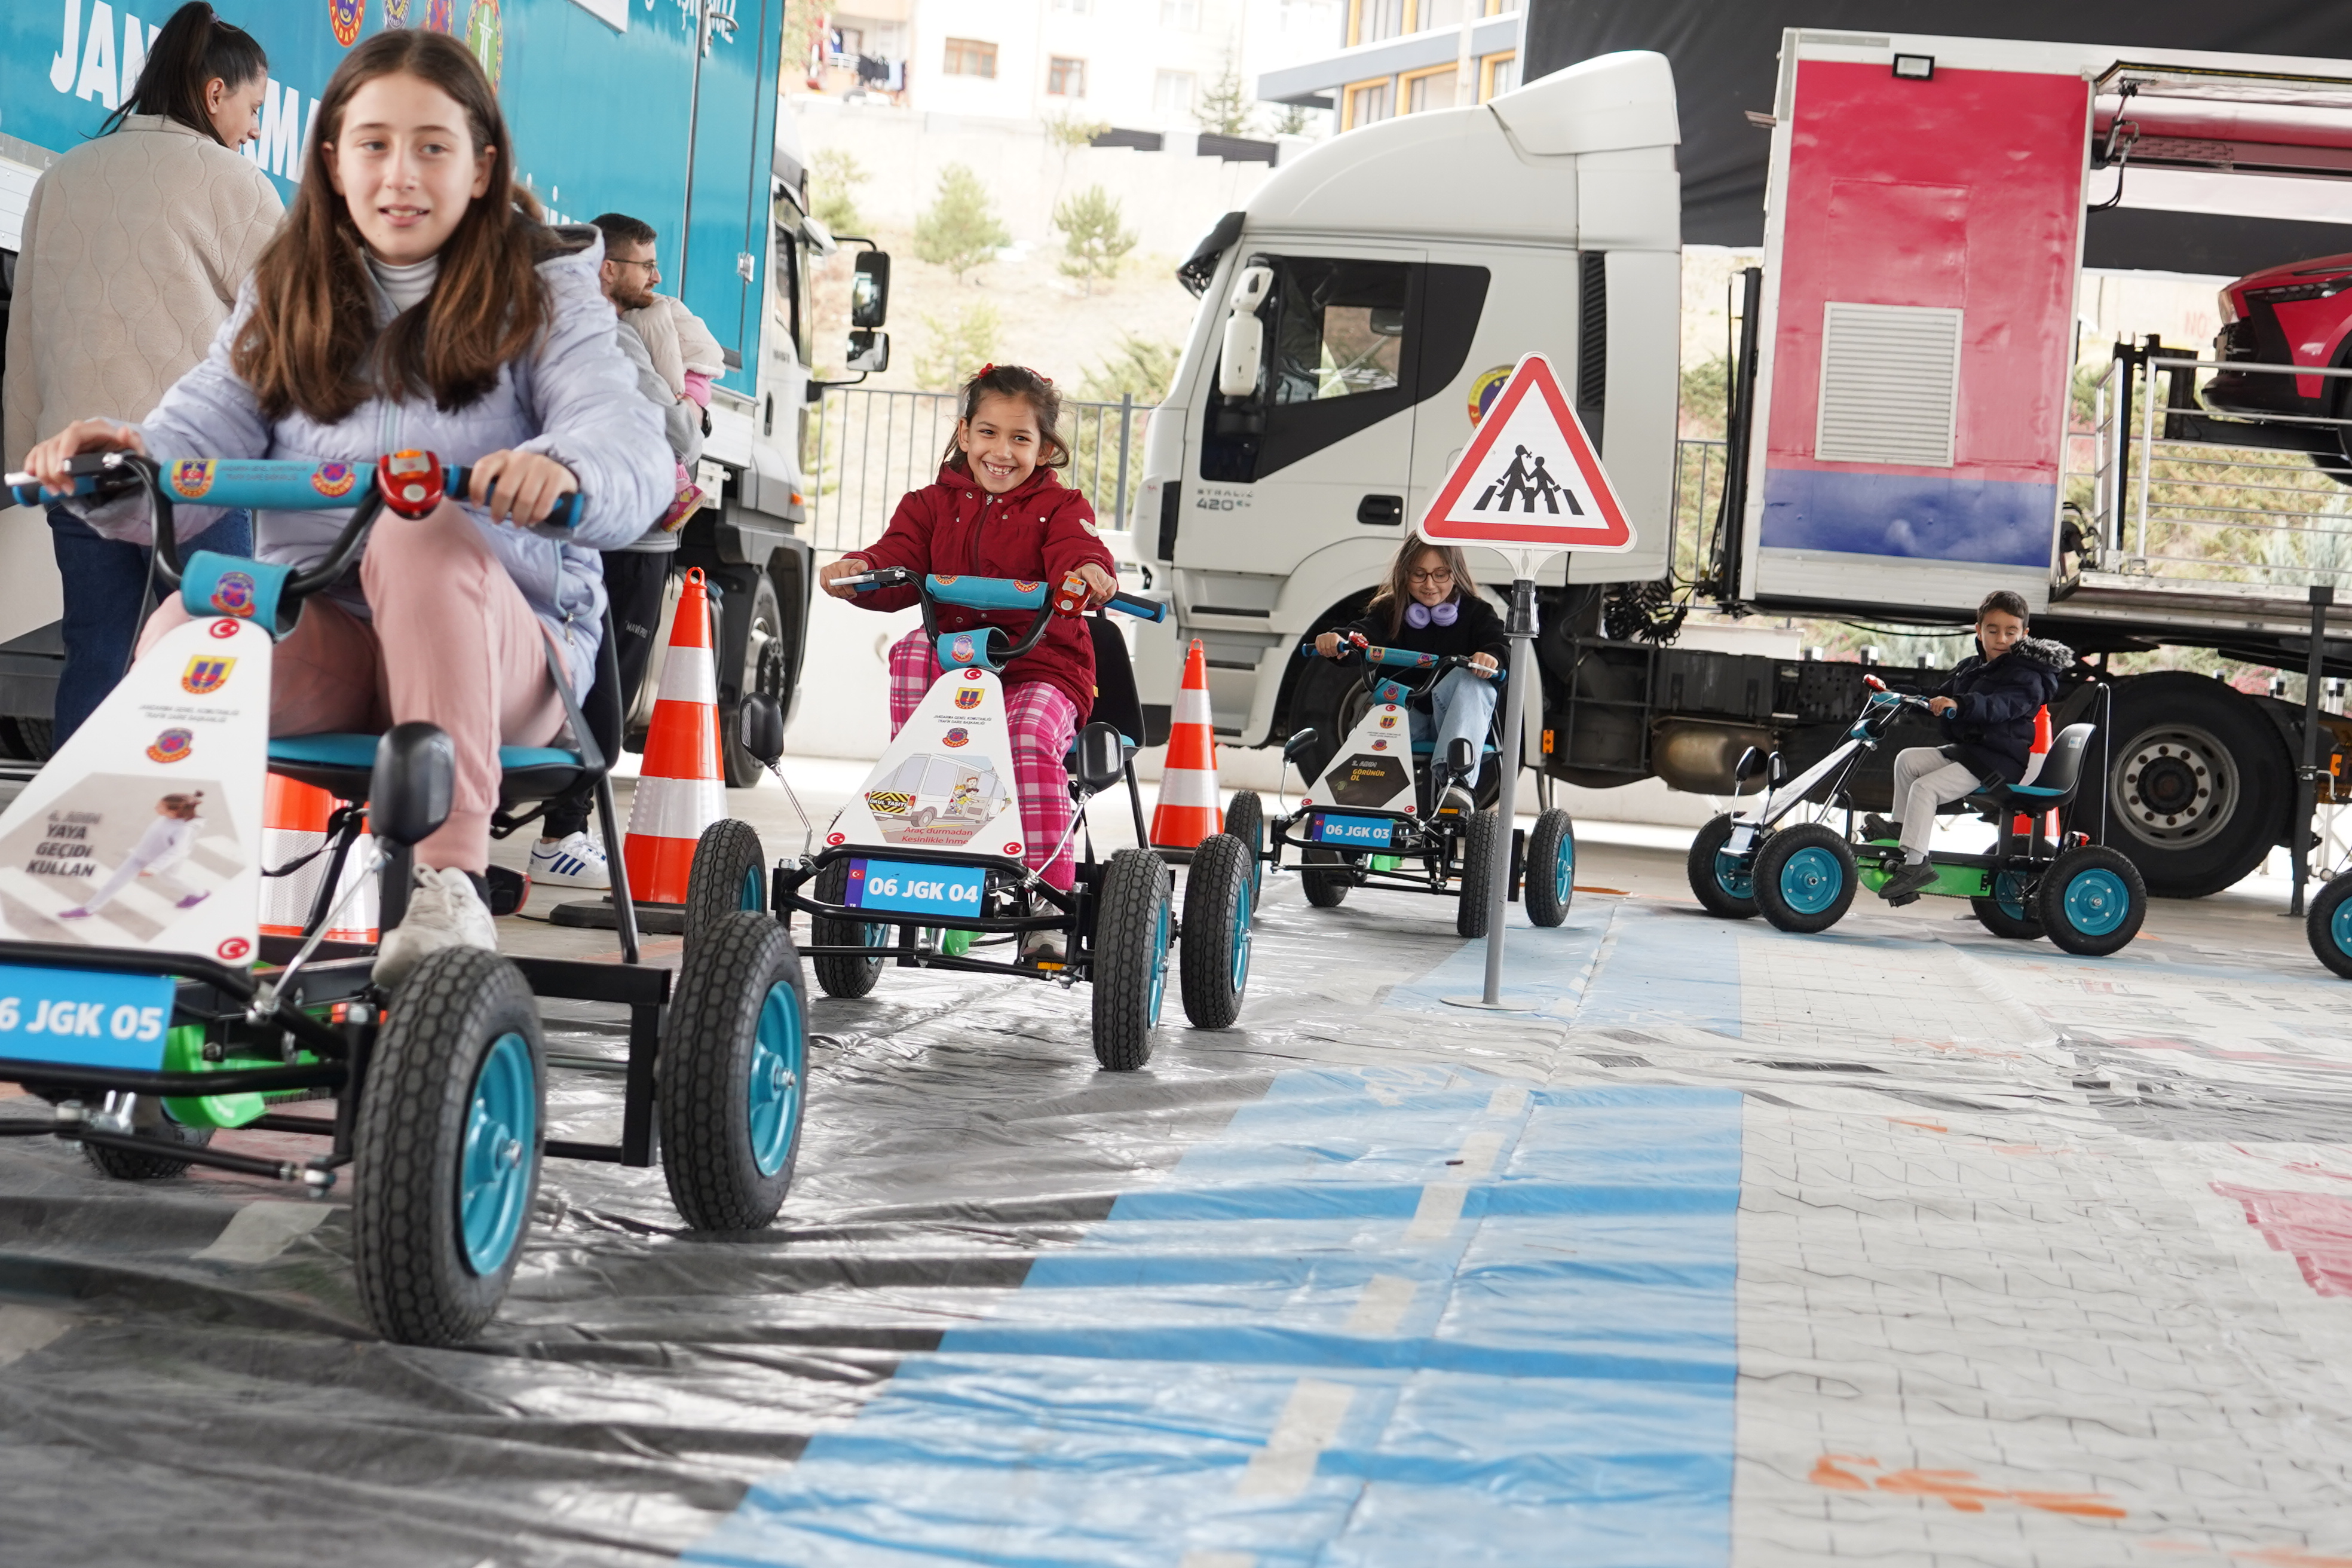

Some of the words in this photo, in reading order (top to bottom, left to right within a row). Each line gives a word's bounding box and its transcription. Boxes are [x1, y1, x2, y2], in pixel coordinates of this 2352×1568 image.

[1196, 498, 1234, 511] 420
[1352, 768, 1385, 777] GÖRÜNÜR
[47, 823, 87, 840] YAYA
[926, 828, 973, 836] durmadan
[1325, 825, 1343, 835] 06
[1345, 826, 1371, 838] JGK
[1373, 828, 1390, 839] 03
[25, 859, 97, 877] KULLAN
[869, 877, 898, 896] 06
[902, 880, 945, 900] JGK
[949, 884, 978, 903] 04
[26, 1000, 105, 1037] JGK
[110, 1004, 163, 1041] 05
